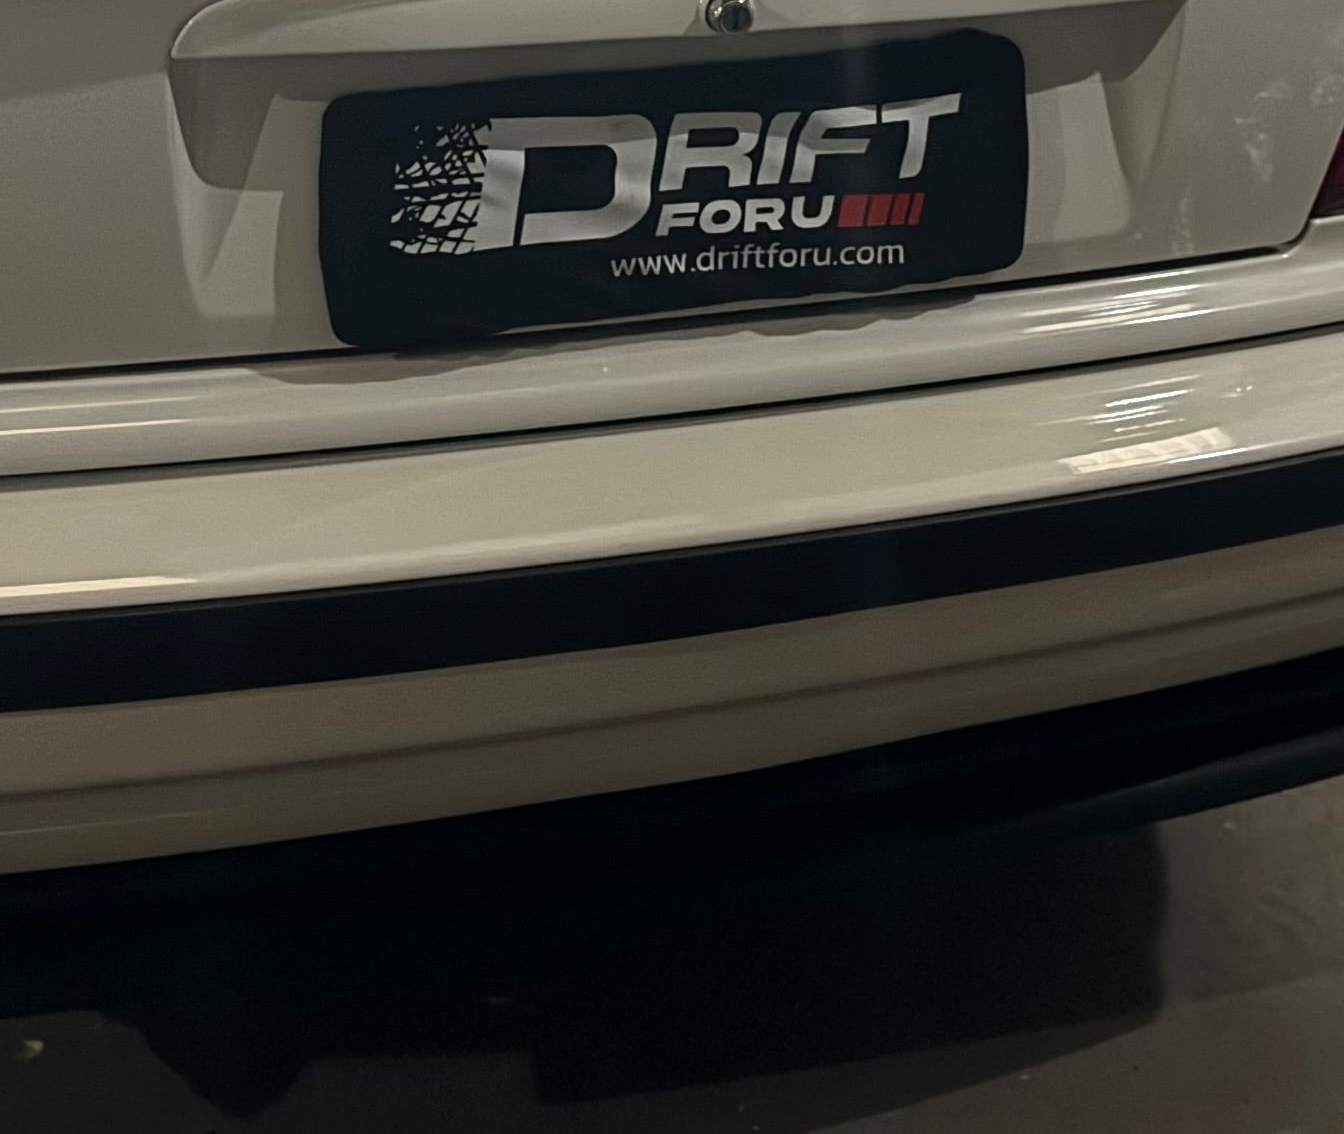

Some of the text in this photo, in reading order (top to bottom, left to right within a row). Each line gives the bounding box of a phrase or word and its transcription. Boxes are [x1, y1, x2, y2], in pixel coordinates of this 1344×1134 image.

[468, 92, 962, 252] DRIFT
[655, 194, 836, 237] FORU
[611, 242, 905, 277] www.driftforu.com
